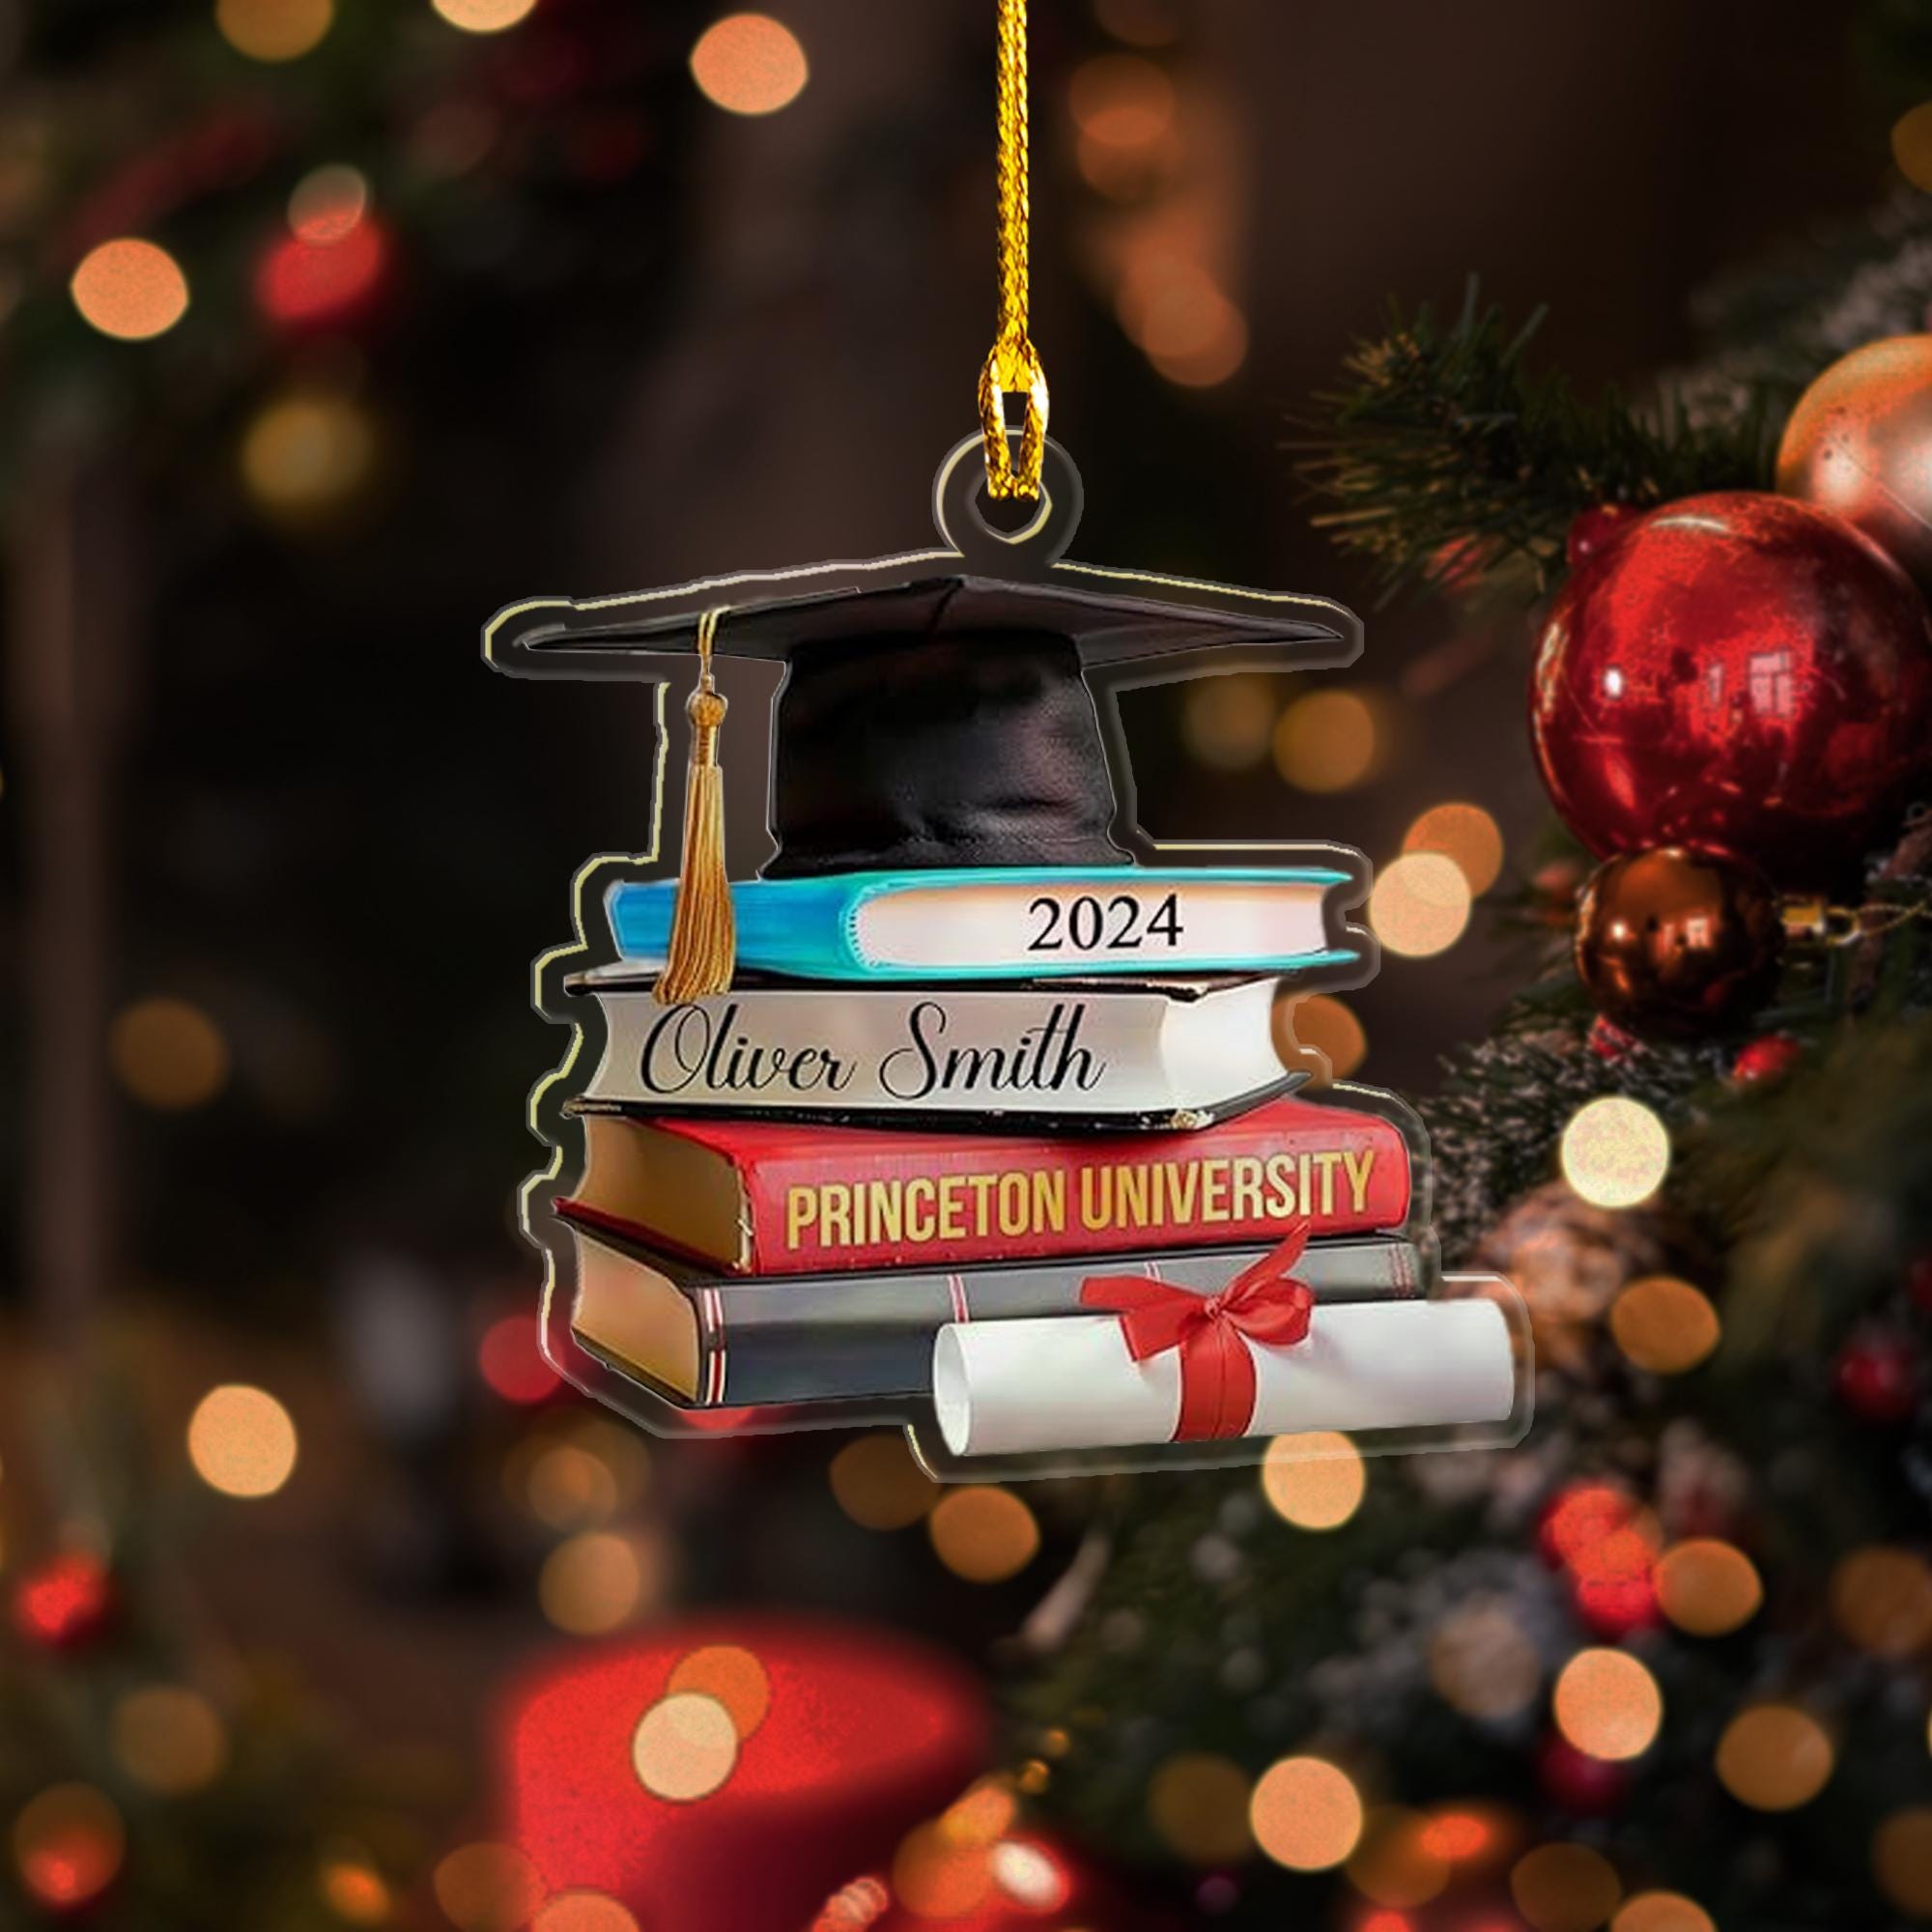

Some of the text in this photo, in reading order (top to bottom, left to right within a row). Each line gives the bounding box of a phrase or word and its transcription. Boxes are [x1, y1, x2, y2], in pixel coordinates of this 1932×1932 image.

[1028, 894, 1184, 952] 2024
[640, 1001, 1106, 1100] Oliver Smith
[785, 1151, 1375, 1248] PRINCETON UNIVERSITY
